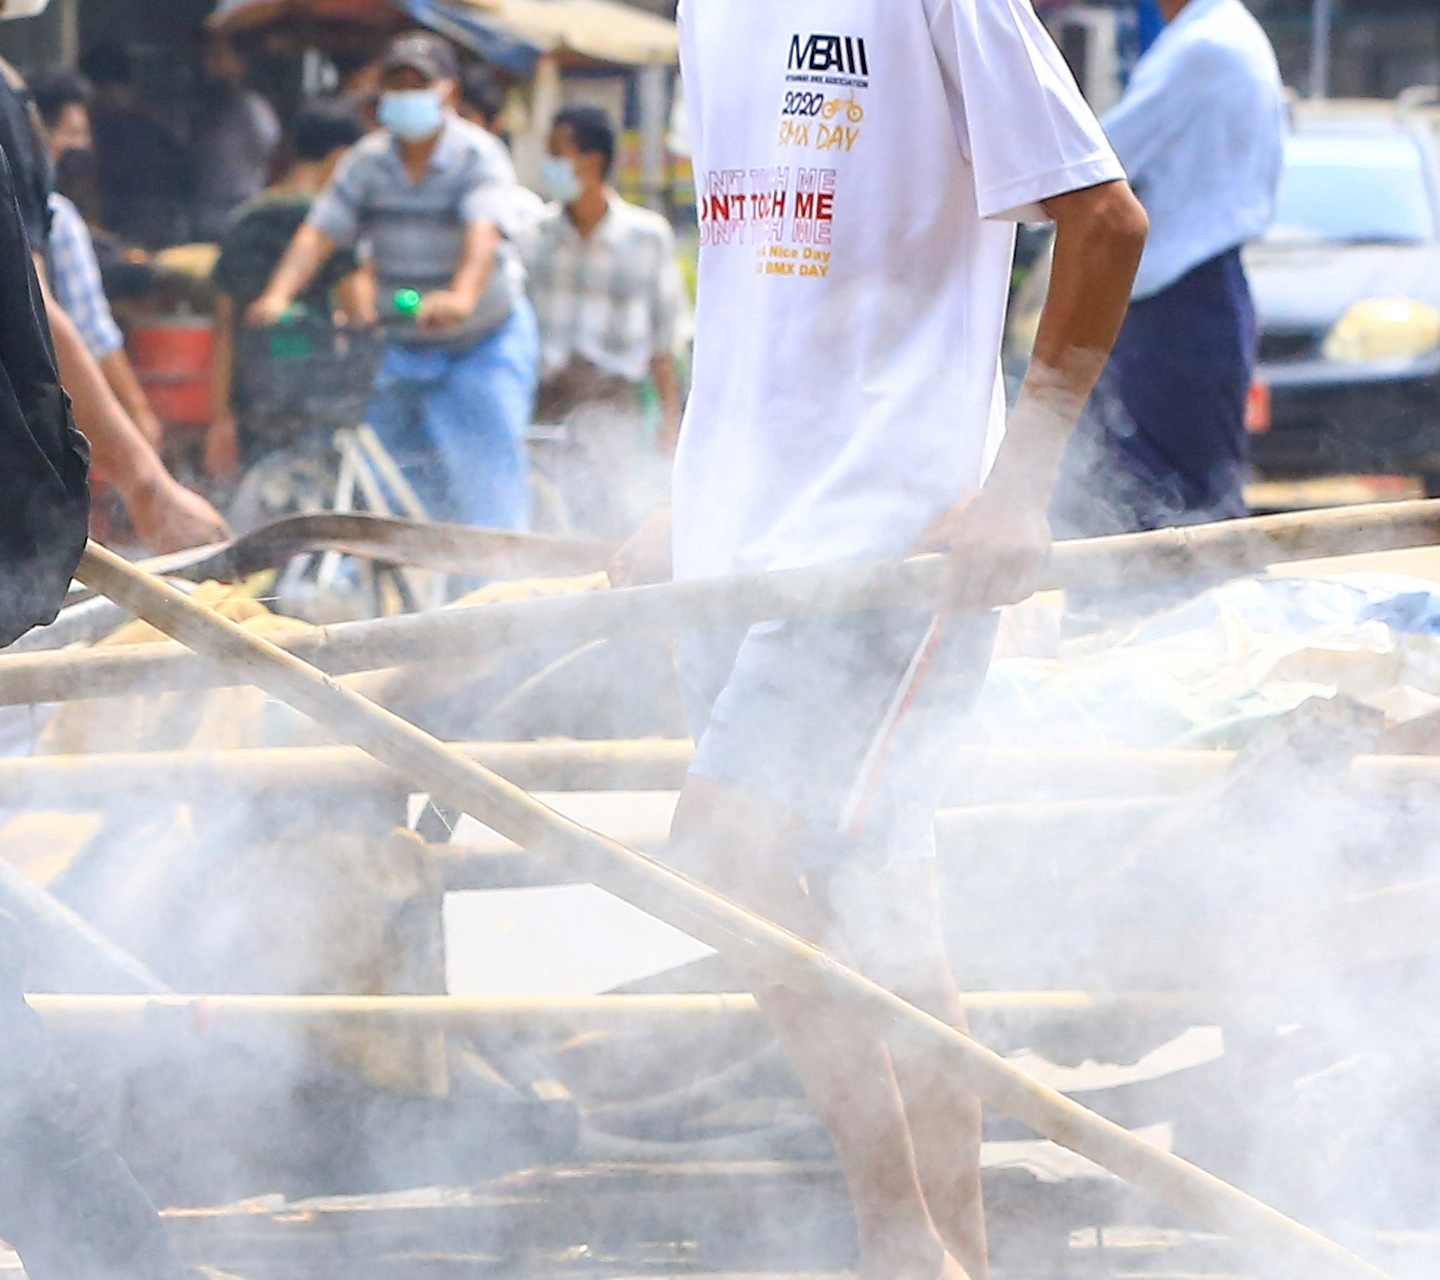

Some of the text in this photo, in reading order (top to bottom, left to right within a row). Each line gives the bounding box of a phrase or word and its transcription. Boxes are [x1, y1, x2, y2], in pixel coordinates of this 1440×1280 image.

[782, 90, 824, 117] 2020
[816, 123, 859, 152] DAY
[797, 166, 837, 193] ME
[794, 191, 834, 220] ME
[792, 219, 833, 245] ME
[803, 247, 831, 263] Day
[799, 264, 830, 278] DAY
